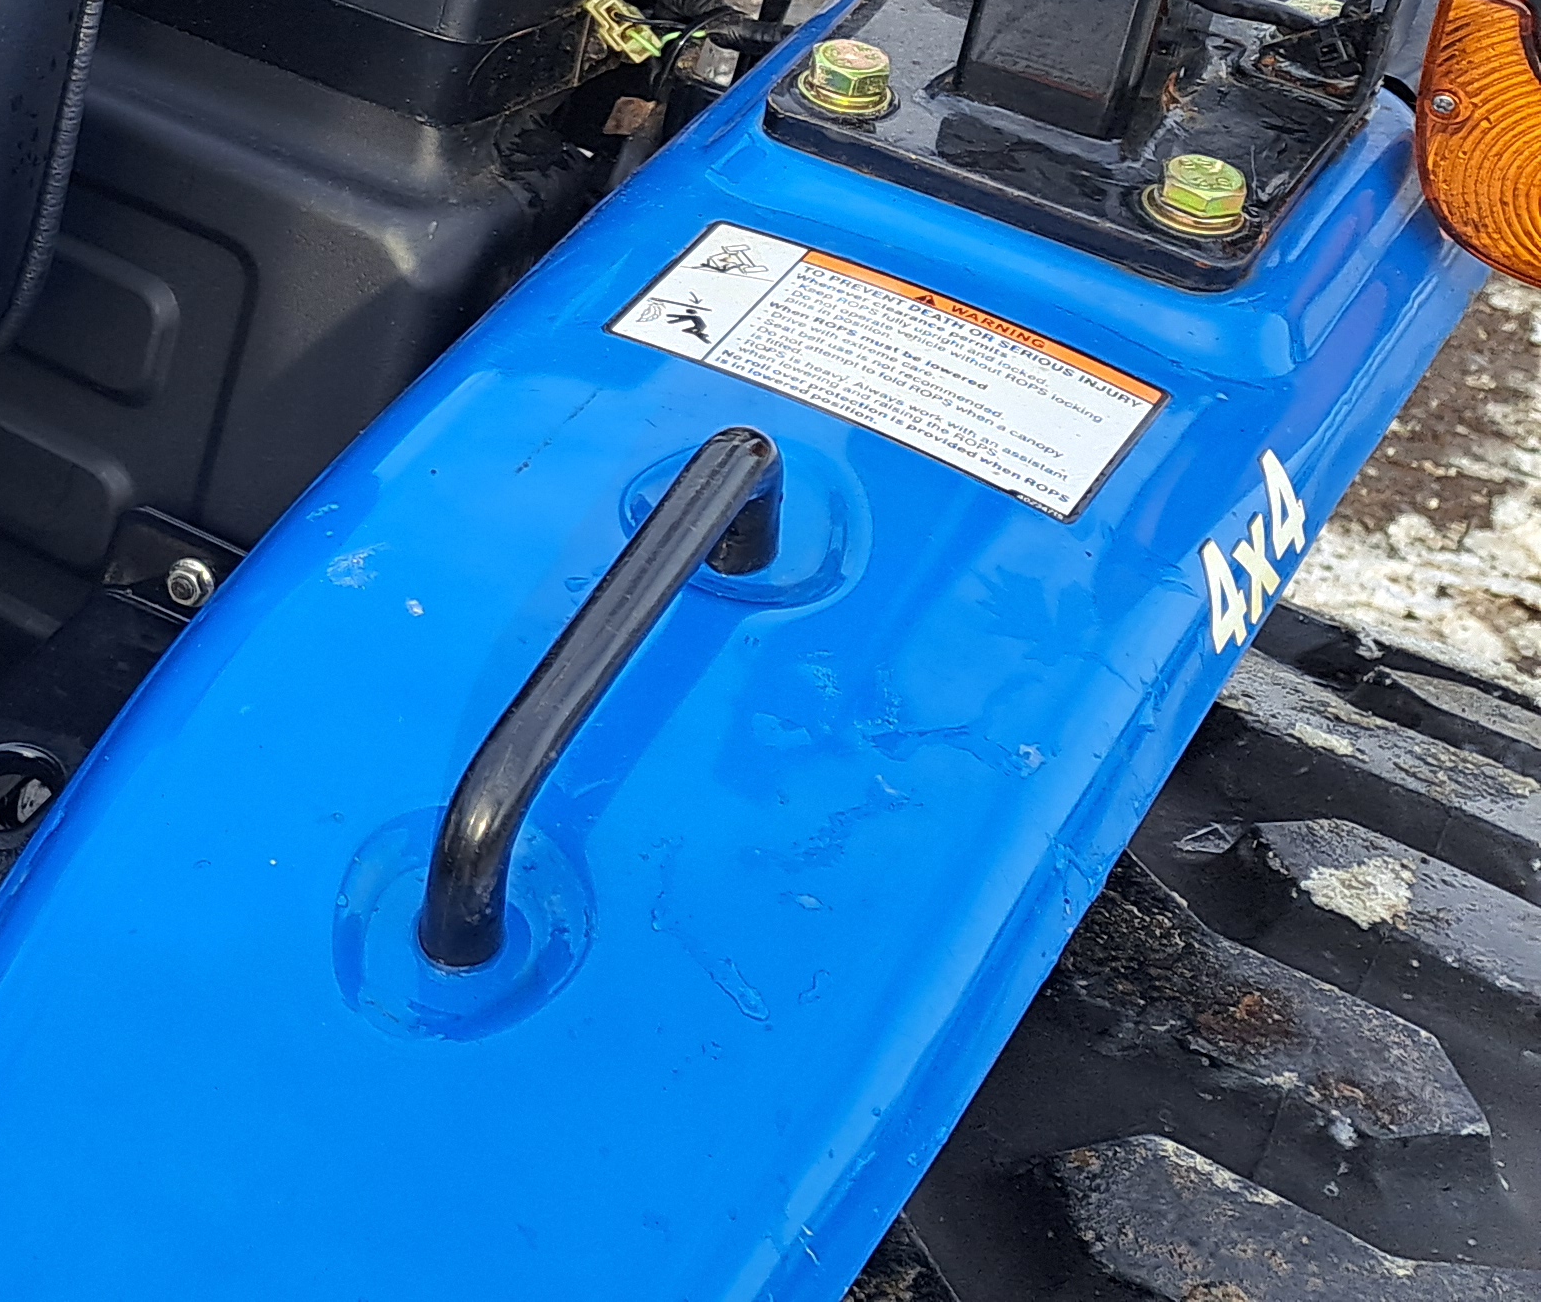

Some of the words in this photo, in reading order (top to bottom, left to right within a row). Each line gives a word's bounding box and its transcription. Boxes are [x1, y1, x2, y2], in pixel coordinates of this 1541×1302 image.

[763, 318, 795, 334] Seat
[871, 359, 896, 372] not
[769, 301, 809, 319] When
[812, 316, 857, 336] ROPS
[860, 335, 899, 353] must
[902, 350, 921, 362] be
[924, 360, 988, 390] lowered
[770, 310, 806, 327] Drive
[810, 326, 838, 339] with
[841, 338, 898, 362] extreme
[796, 272, 869, 302] Whenever
[872, 301, 945, 331] clearance
[948, 331, 1007, 358] permits
[797, 283, 833, 299] Keep
[836, 297, 879, 315] ROPS
[881, 312, 911, 328] fully
[913, 326, 964, 349] upright
[966, 348, 995, 362] and
[804, 265, 825, 277] TO
[828, 275, 906, 305] PREVENT
[907, 303, 965, 329] DEATH
[968, 328, 994, 342] OR
[993, 340, 1074, 376] SERIOUS
[1077, 374, 1144, 407] INJURY
[817, 307, 831, 316] in
[948, 305, 1047, 348] WARNING
[714, 355, 728, 364] is
[731, 361, 745, 371] in
[747, 367, 809, 394] lowered
[738, 346, 775, 363] when
[778, 360, 839, 389] lowering
[842, 387, 871, 400] and
[926, 421, 949, 434] the
[756, 325, 777, 336] Do
[779, 335, 803, 346] not
[861, 365, 875, 374] to
[908, 384, 953, 407] ROPS
[955, 405, 994, 425] when
[1009, 430, 1063, 458] canopy
[790, 289, 811, 300] Do
[813, 298, 837, 310] not
[839, 308, 893, 330] operate
[897, 329, 946, 351] vehicle
[950, 350, 1002, 376] without
[1004, 373, 1048, 395] ROPS
[1050, 393, 1102, 423] locking
[721, 349, 742, 360] No
[744, 359, 771, 371] roll
[772, 369, 806, 384] over
[807, 383, 887, 418] protection
[889, 415, 903, 425] is
[905, 424, 977, 458] provided
[979, 456, 1021, 479] when
[1023, 477, 1069, 502] ROPS
[743, 338, 785, 358] ROPS
[788, 355, 801, 364] is
[852, 381, 904, 405] Always
[908, 404, 942, 423] work
[947, 421, 976, 438] with
[979, 437, 998, 448] an
[1001, 447, 1067, 481] assistant
[1200, 448, 1306, 655] 4x4
